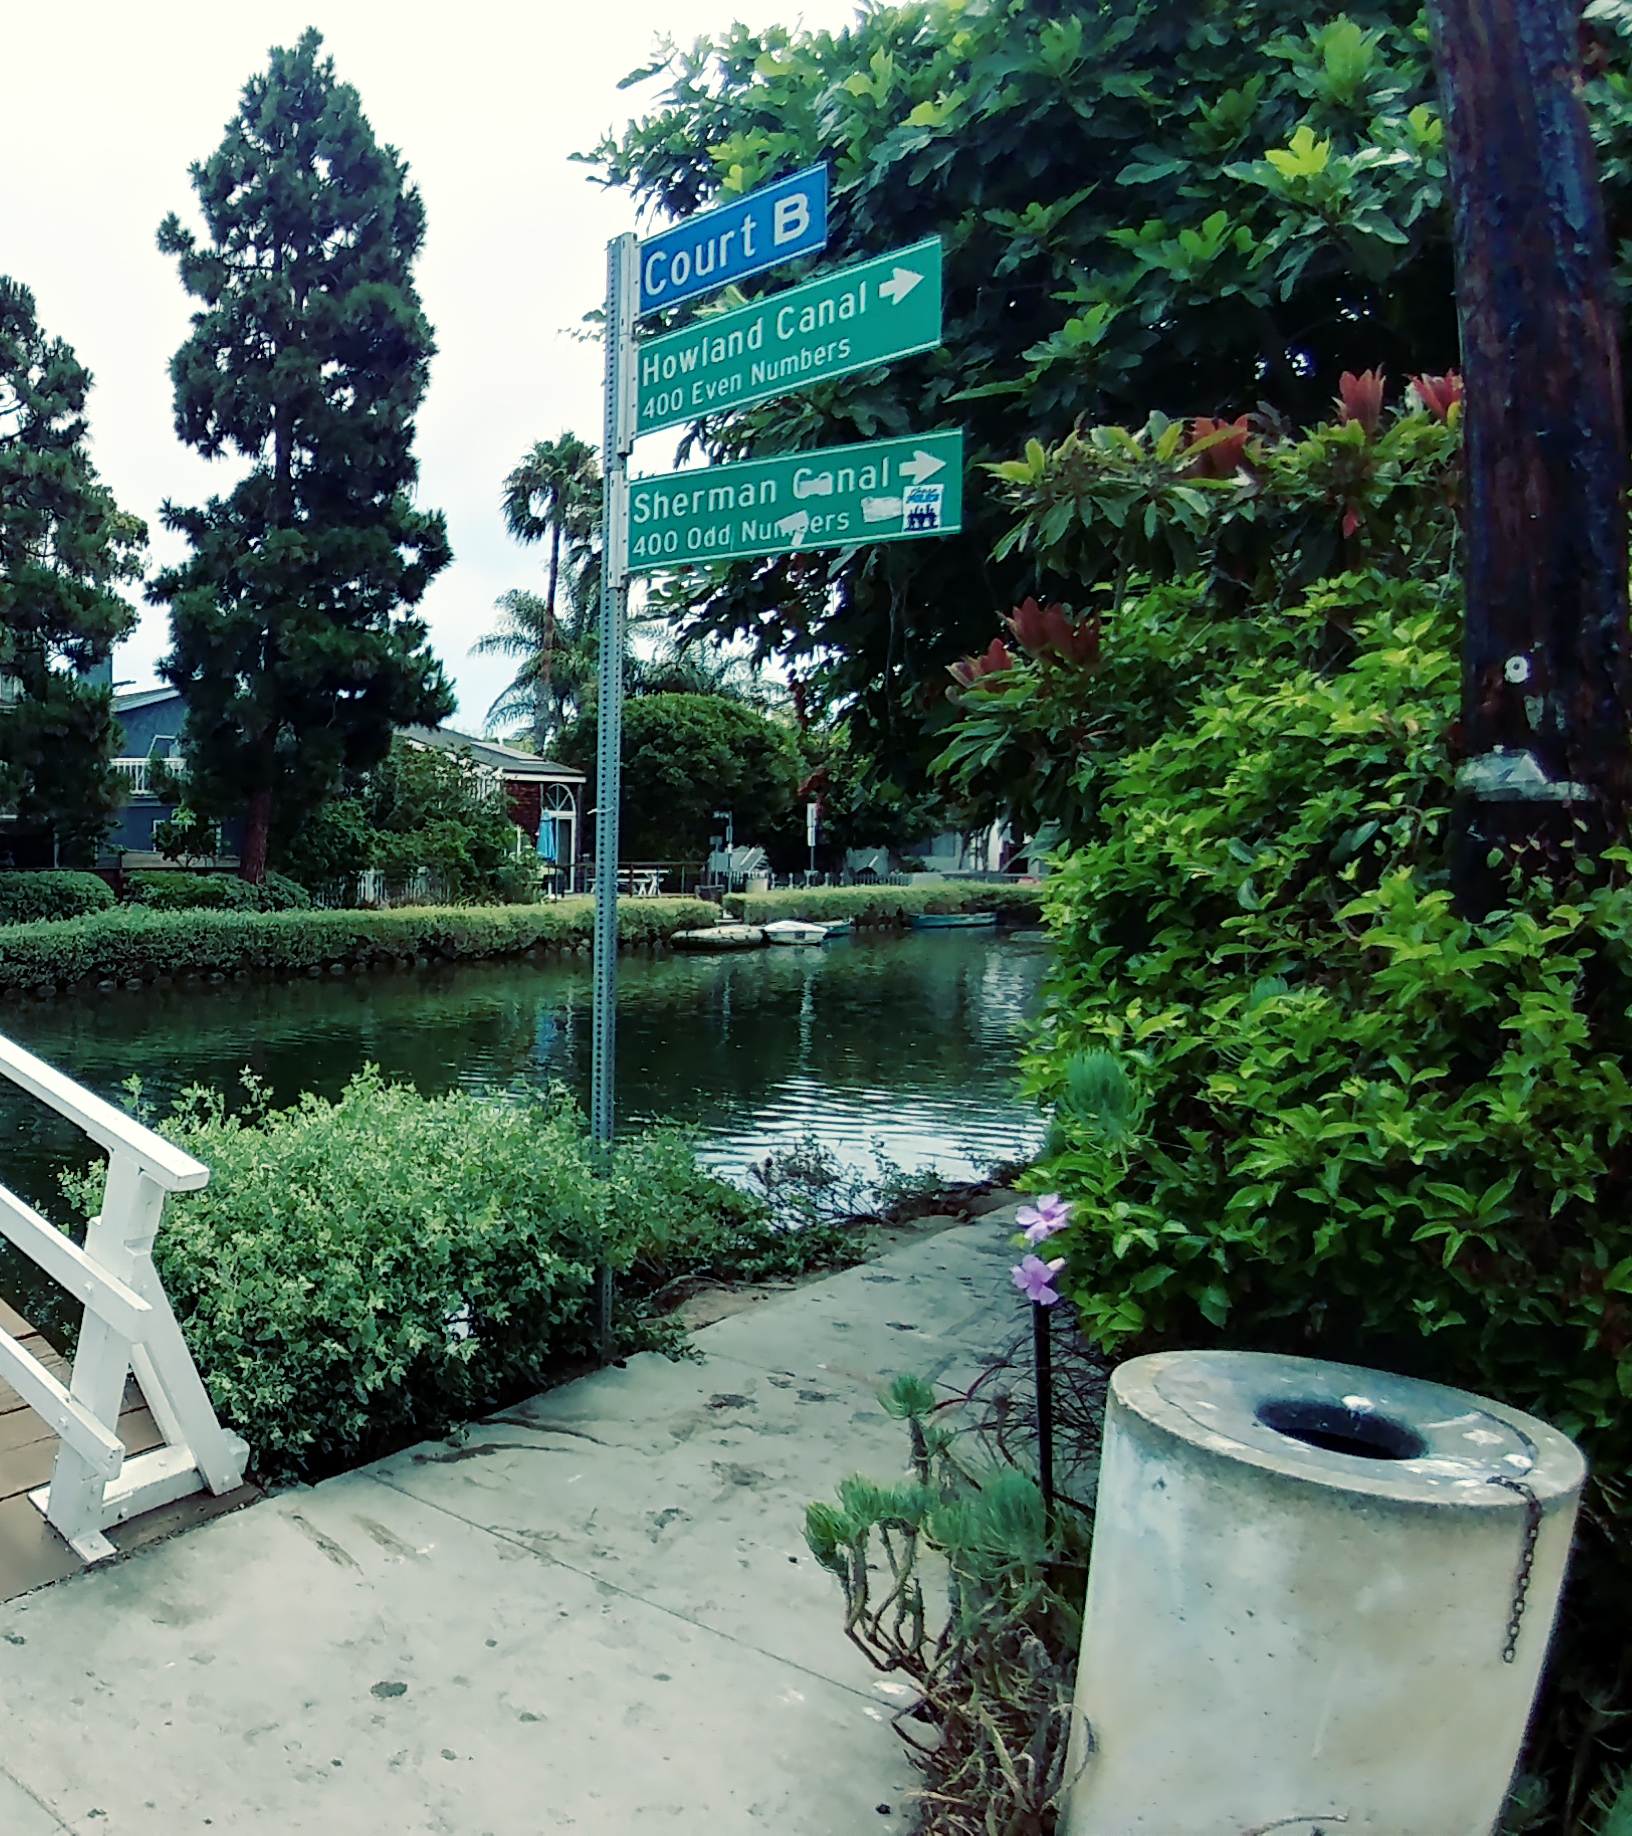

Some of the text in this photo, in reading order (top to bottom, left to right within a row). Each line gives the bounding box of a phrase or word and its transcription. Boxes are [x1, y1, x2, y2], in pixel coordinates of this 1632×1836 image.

[644, 192, 811, 296] Court B
[642, 280, 867, 388] Howland Canal
[641, 337, 852, 419] 400 Even Numbers
[632, 479, 777, 524] Sherman
[632, 511, 850, 558] 400 Odd Nuers
